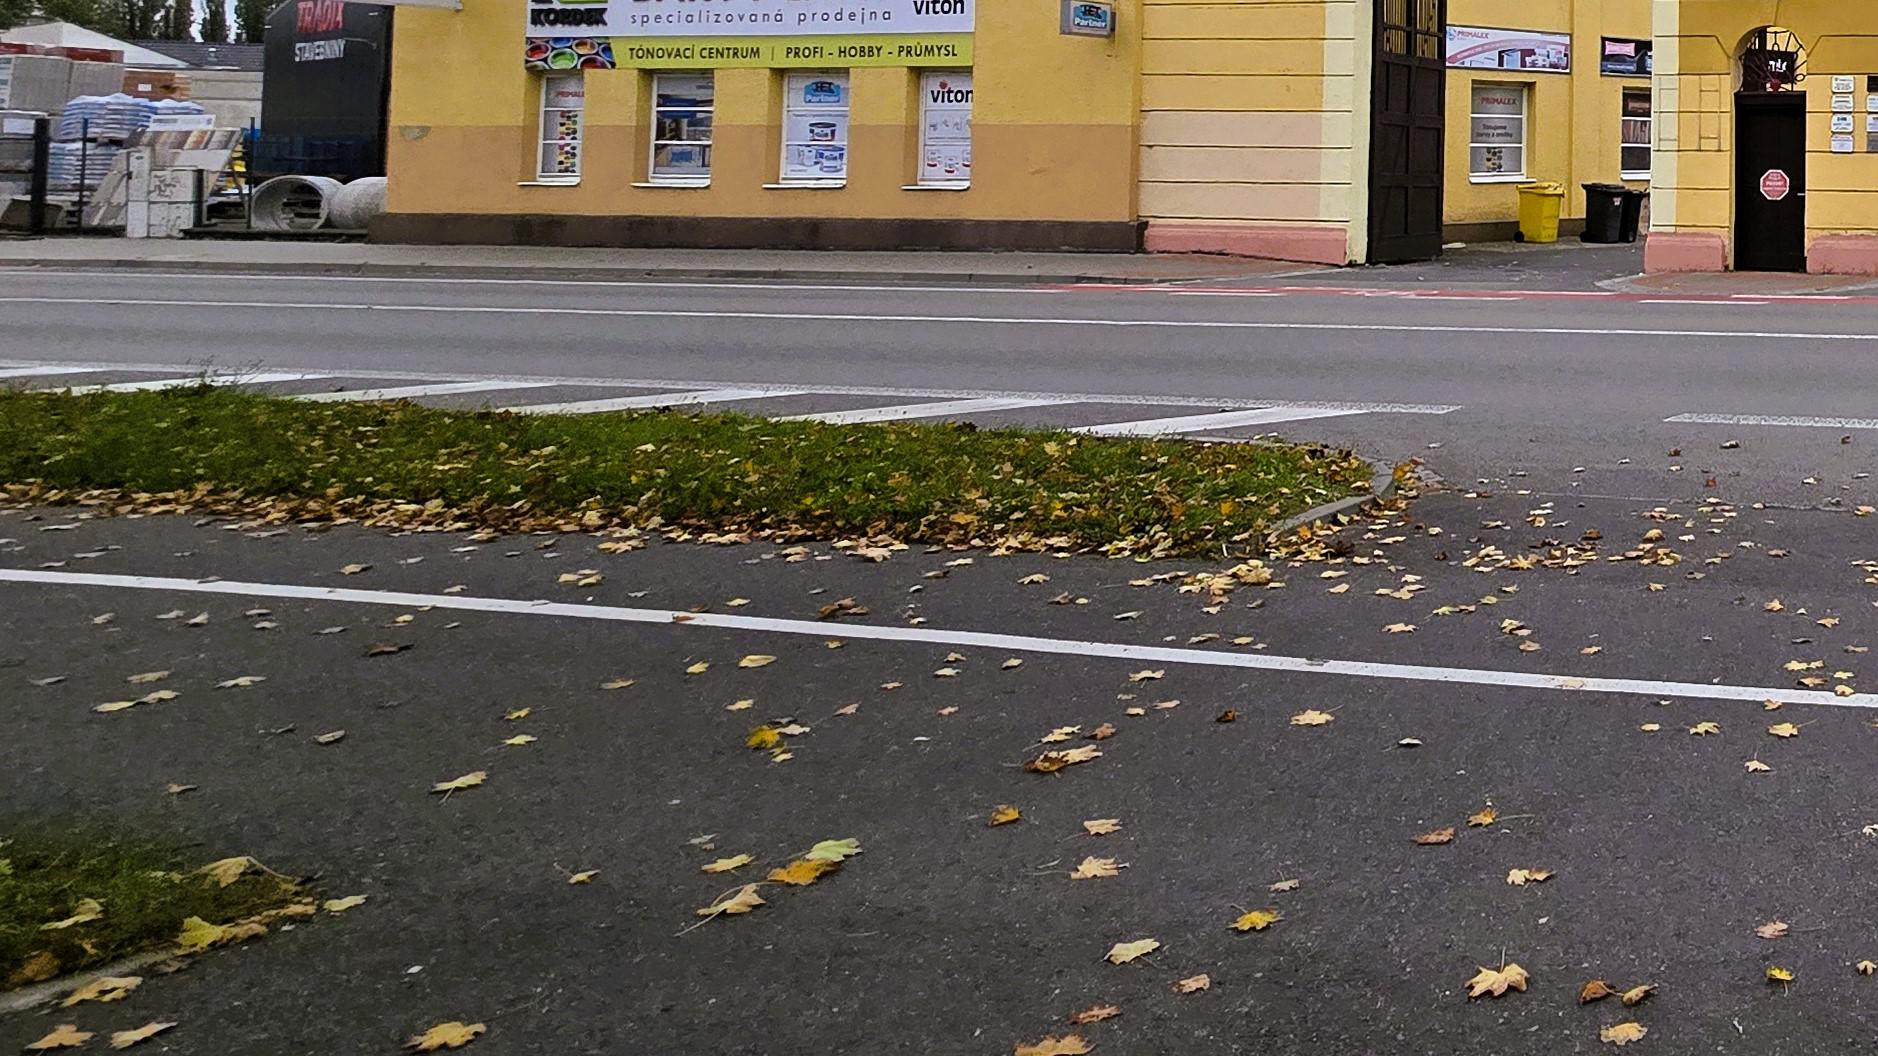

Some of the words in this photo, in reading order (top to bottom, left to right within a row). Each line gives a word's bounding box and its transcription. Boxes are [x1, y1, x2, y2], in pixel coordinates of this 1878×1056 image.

[631, 9, 784, 27] specializovaná
[797, 7, 892, 26] prodejna
[628, 44, 696, 60] TÓNOVACÍ
[700, 46, 761, 60] CENTRUM
[785, 46, 824, 59] PROFI
[837, 45, 884, 59] HOBBY
[897, 41, 958, 58] PRŮMYSL
